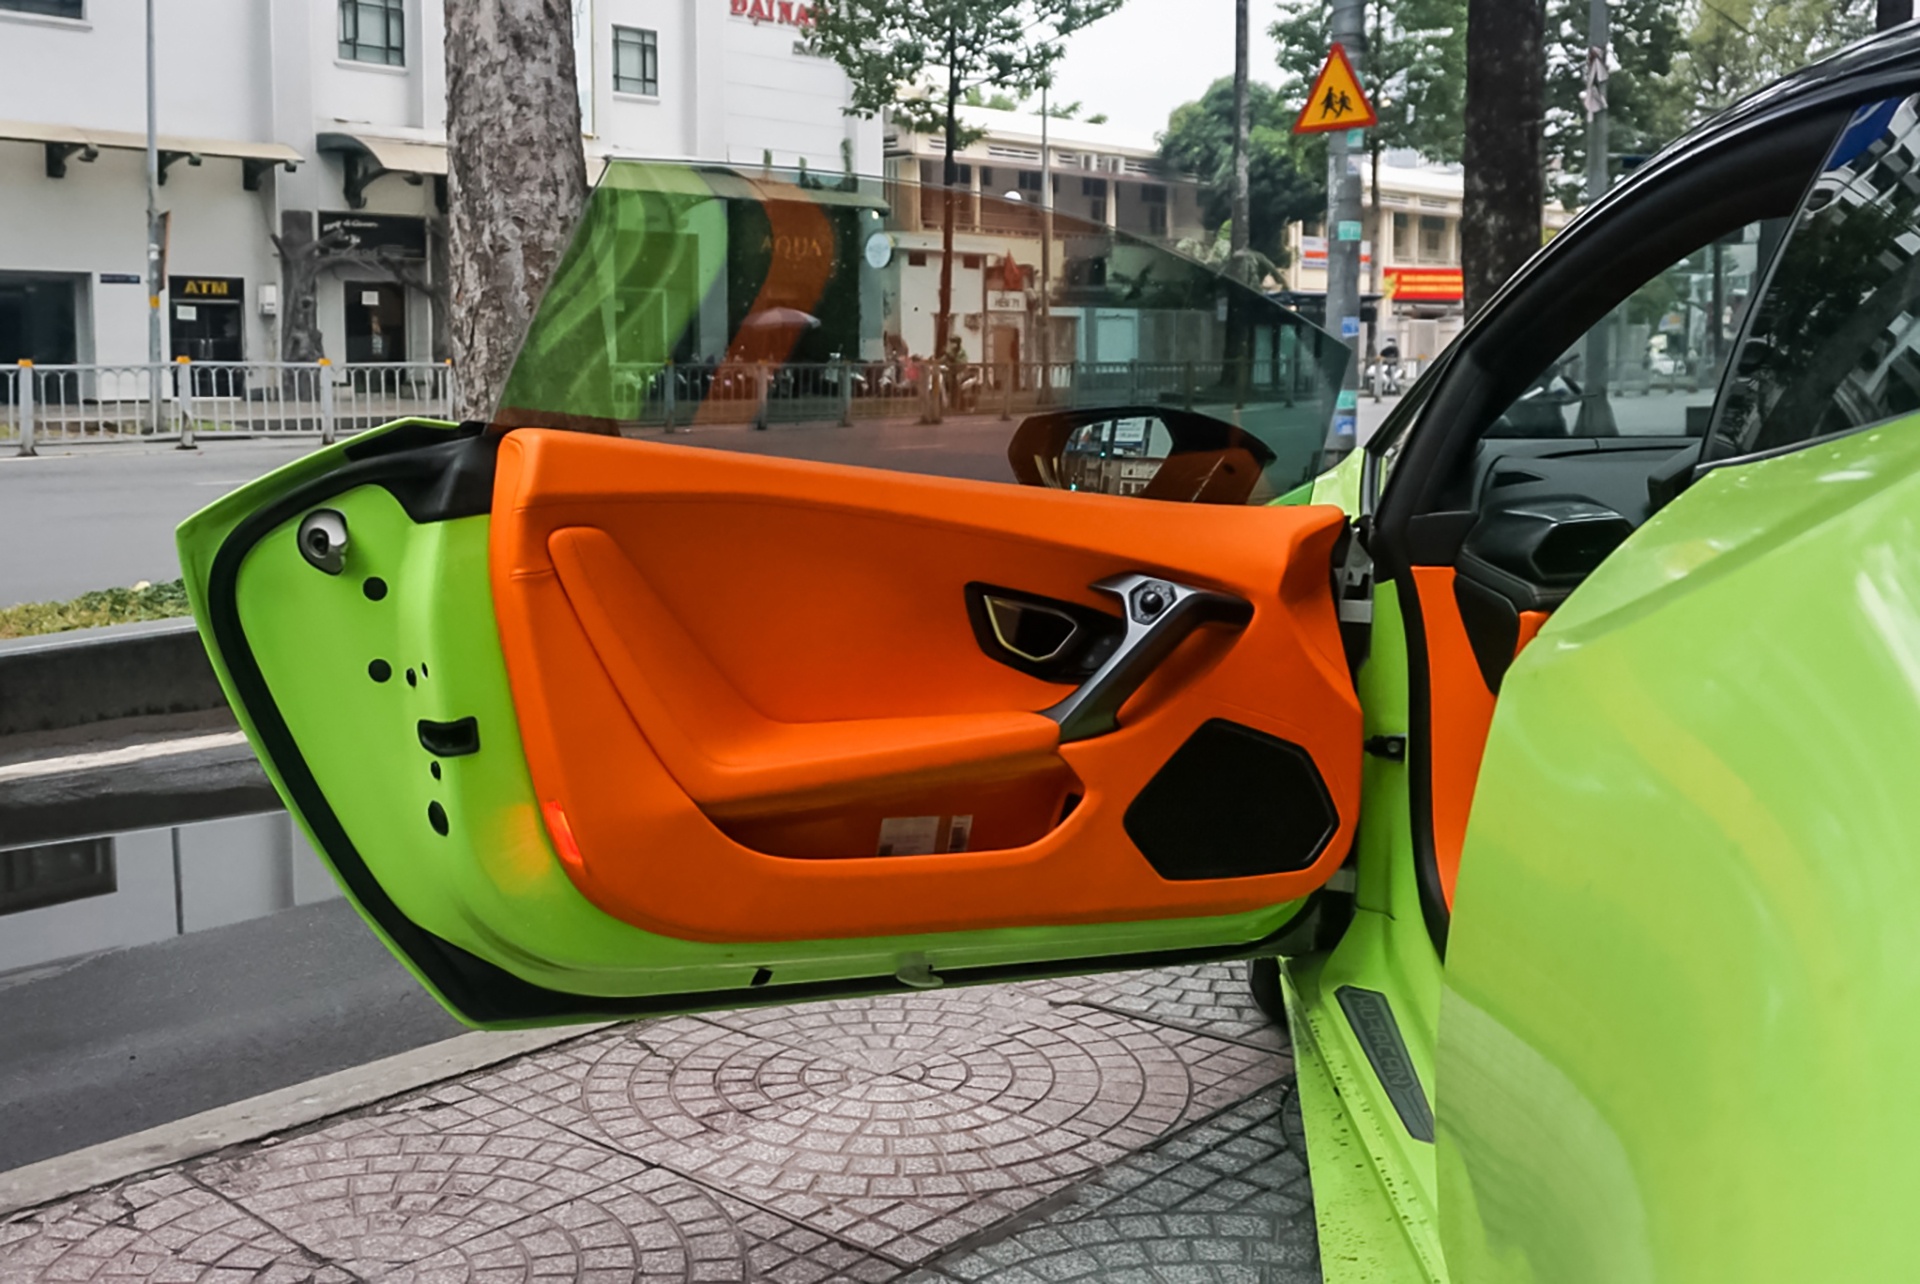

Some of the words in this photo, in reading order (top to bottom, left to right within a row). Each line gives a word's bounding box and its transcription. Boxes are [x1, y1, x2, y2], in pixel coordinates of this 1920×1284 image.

[777, 1, 826, 28] NA
[761, 235, 822, 259] AQUA
[184, 280, 228, 295] ATM
